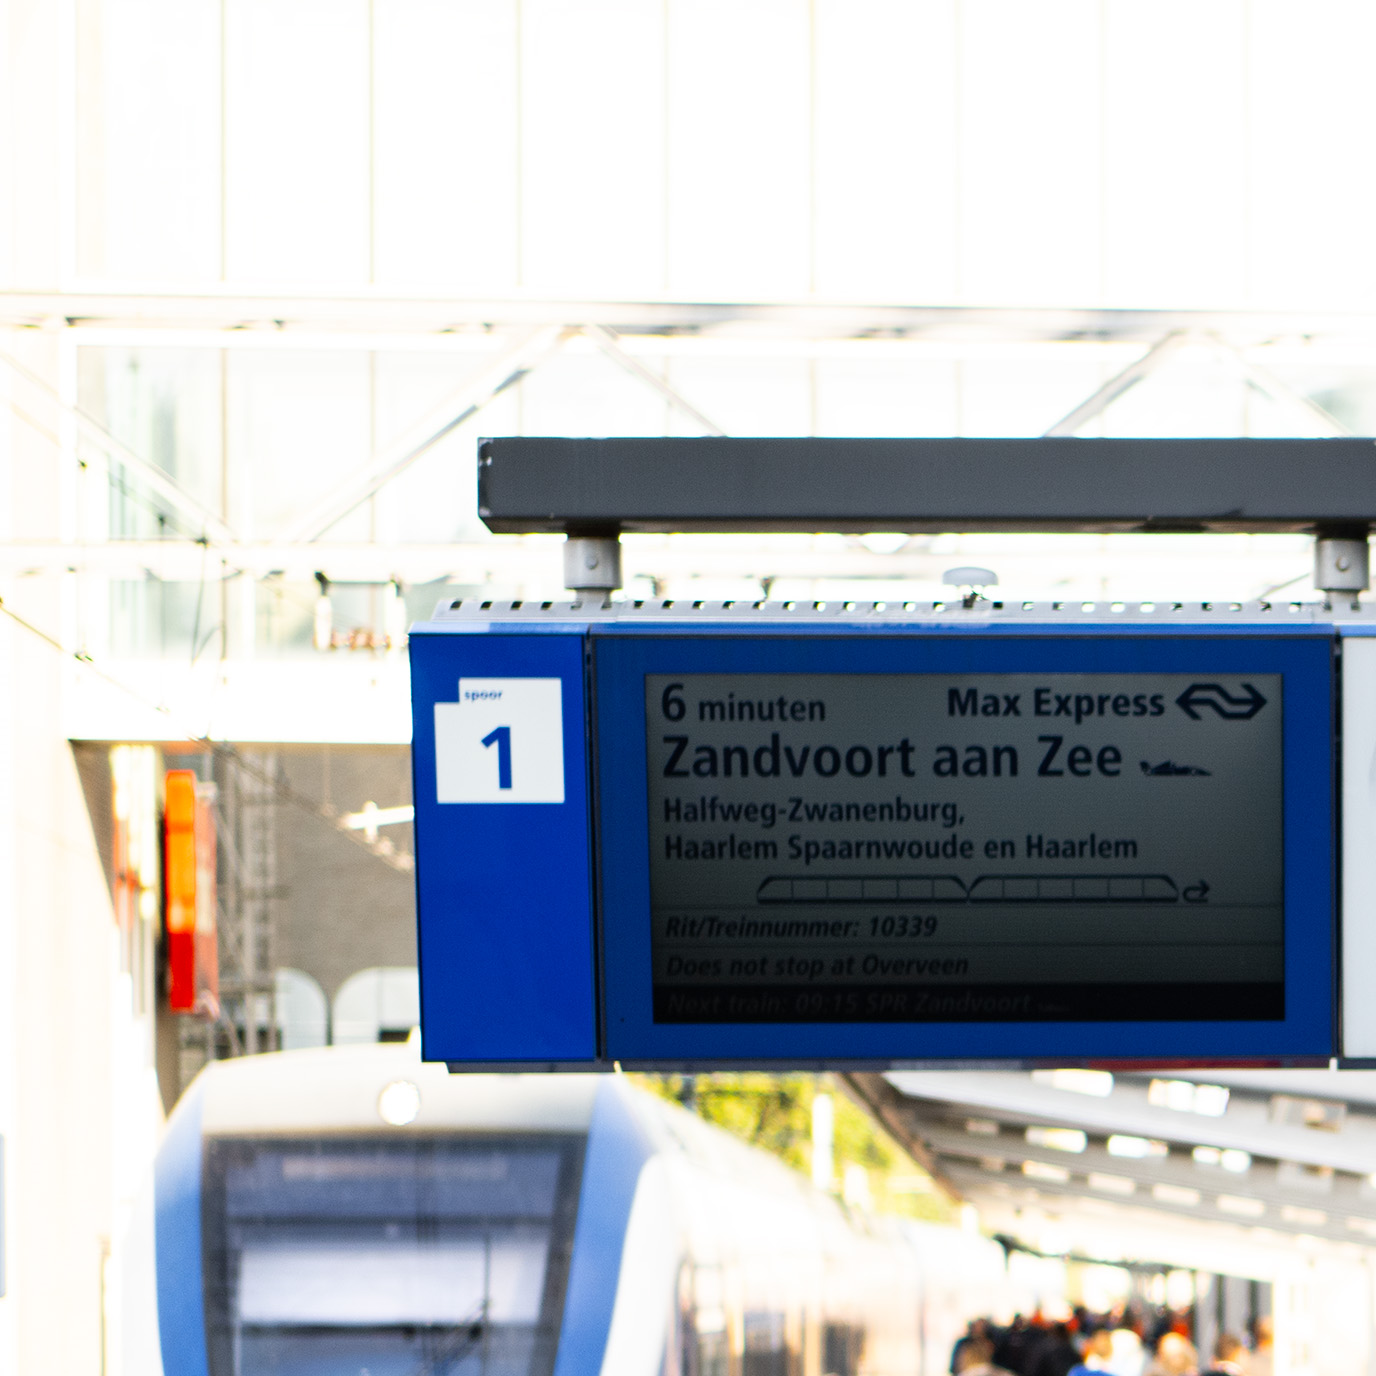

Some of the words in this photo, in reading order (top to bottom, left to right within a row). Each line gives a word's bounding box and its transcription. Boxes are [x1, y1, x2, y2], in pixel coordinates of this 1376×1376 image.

[464, 689, 503, 701] spoor
[661, 682, 686, 722] 6
[699, 693, 826, 721] minuten
[948, 687, 1021, 718] Max
[1034, 688, 1165, 723] Express
[481, 726, 513, 789] 1
[662, 732, 916, 777] Zandvoort
[932, 744, 1019, 778] aan
[1036, 735, 1123, 778] Zee
[664, 797, 966, 828] Halfweg-Zwanenburg,
[665, 834, 778, 861] Haarlem
[788, 835, 974, 865] Spaarnwoude
[984, 840, 1017, 860] en
[1027, 834, 1139, 860] Haarlem
[665, 915, 860, 941] Rit/Treinnummer:
[870, 917, 938, 938] 10339
[666, 954, 721, 975] Does
[730, 957, 768, 976] not
[775, 957, 825, 981] stop
[831, 957, 855, 976] at
[862, 956, 970, 976] Overveen
[666, 992, 722, 1014] Next
[729, 993, 790, 1014] train:
[913, 991, 1034, 1013] Zandvoort
